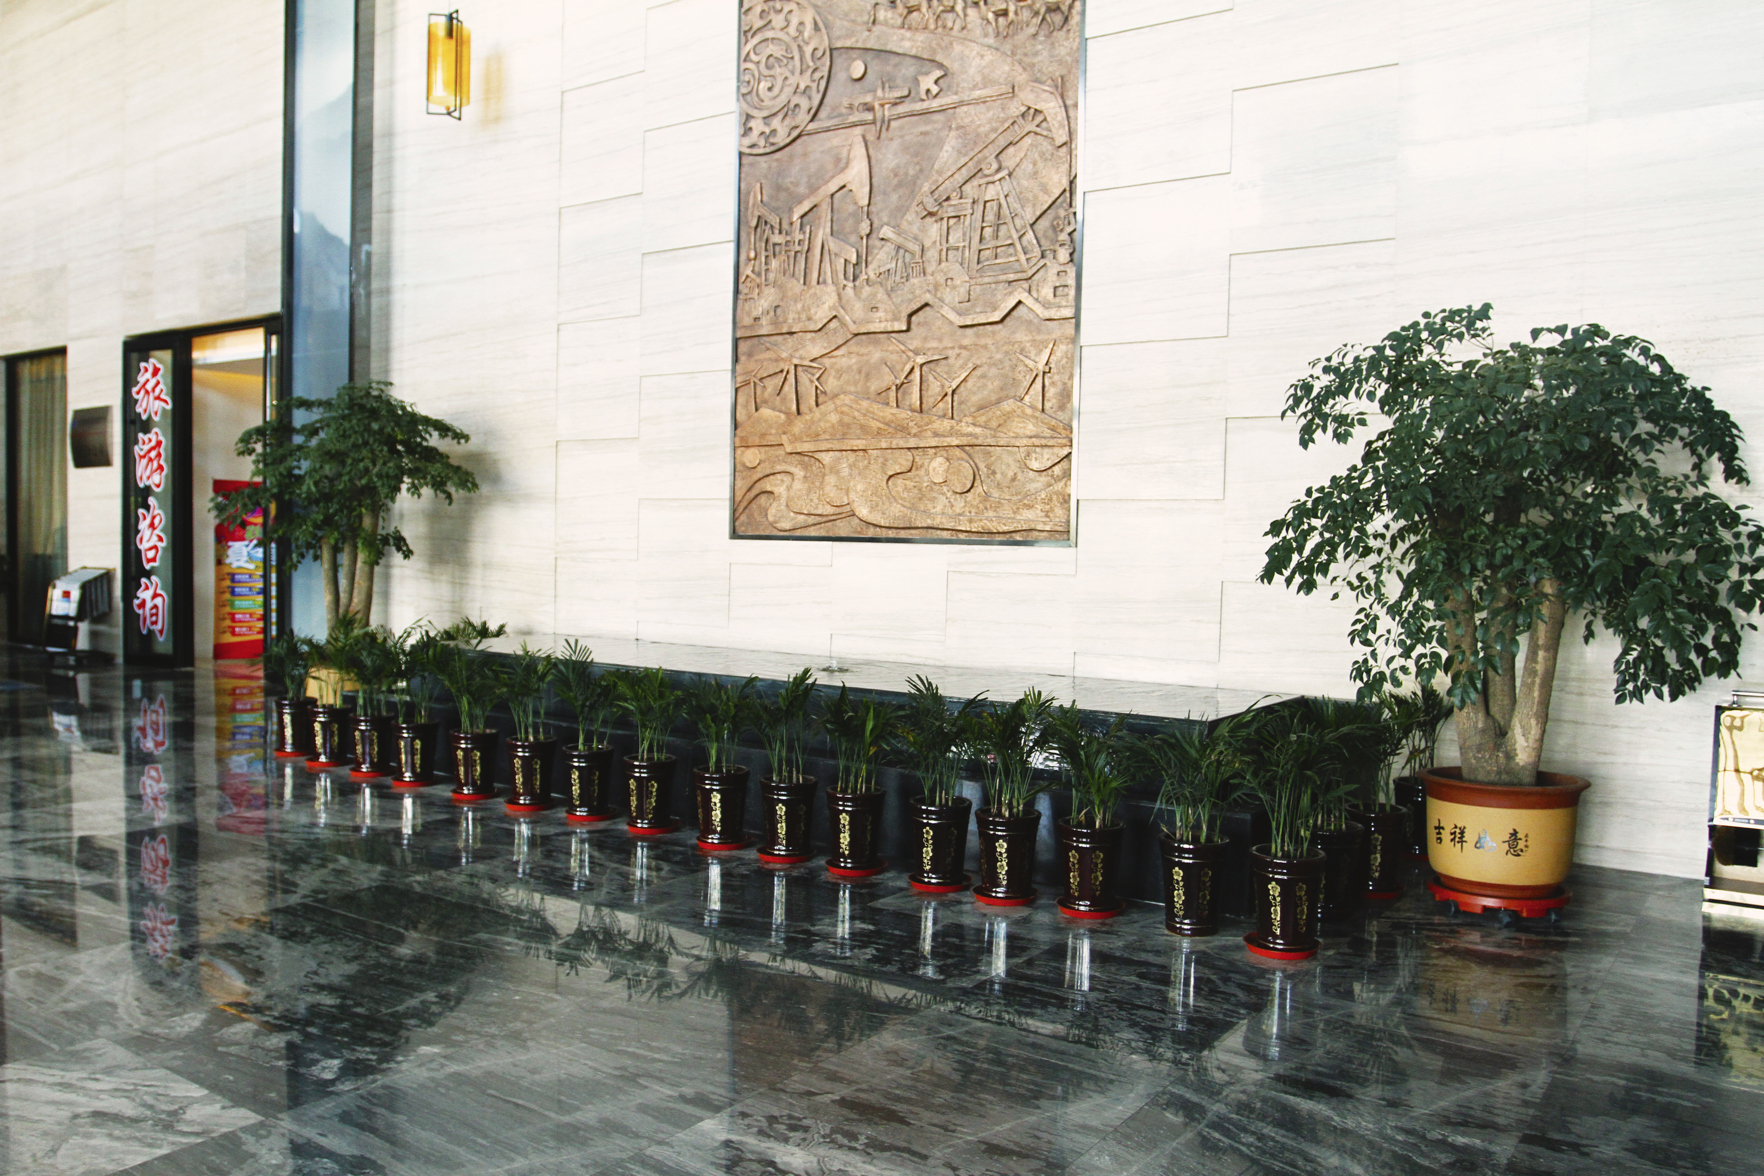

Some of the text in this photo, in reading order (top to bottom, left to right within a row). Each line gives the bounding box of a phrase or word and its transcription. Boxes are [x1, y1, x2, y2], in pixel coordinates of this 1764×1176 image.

[132, 358, 172, 642] 旅游咨询
[1433, 818, 1524, 857] 吉祥如意
